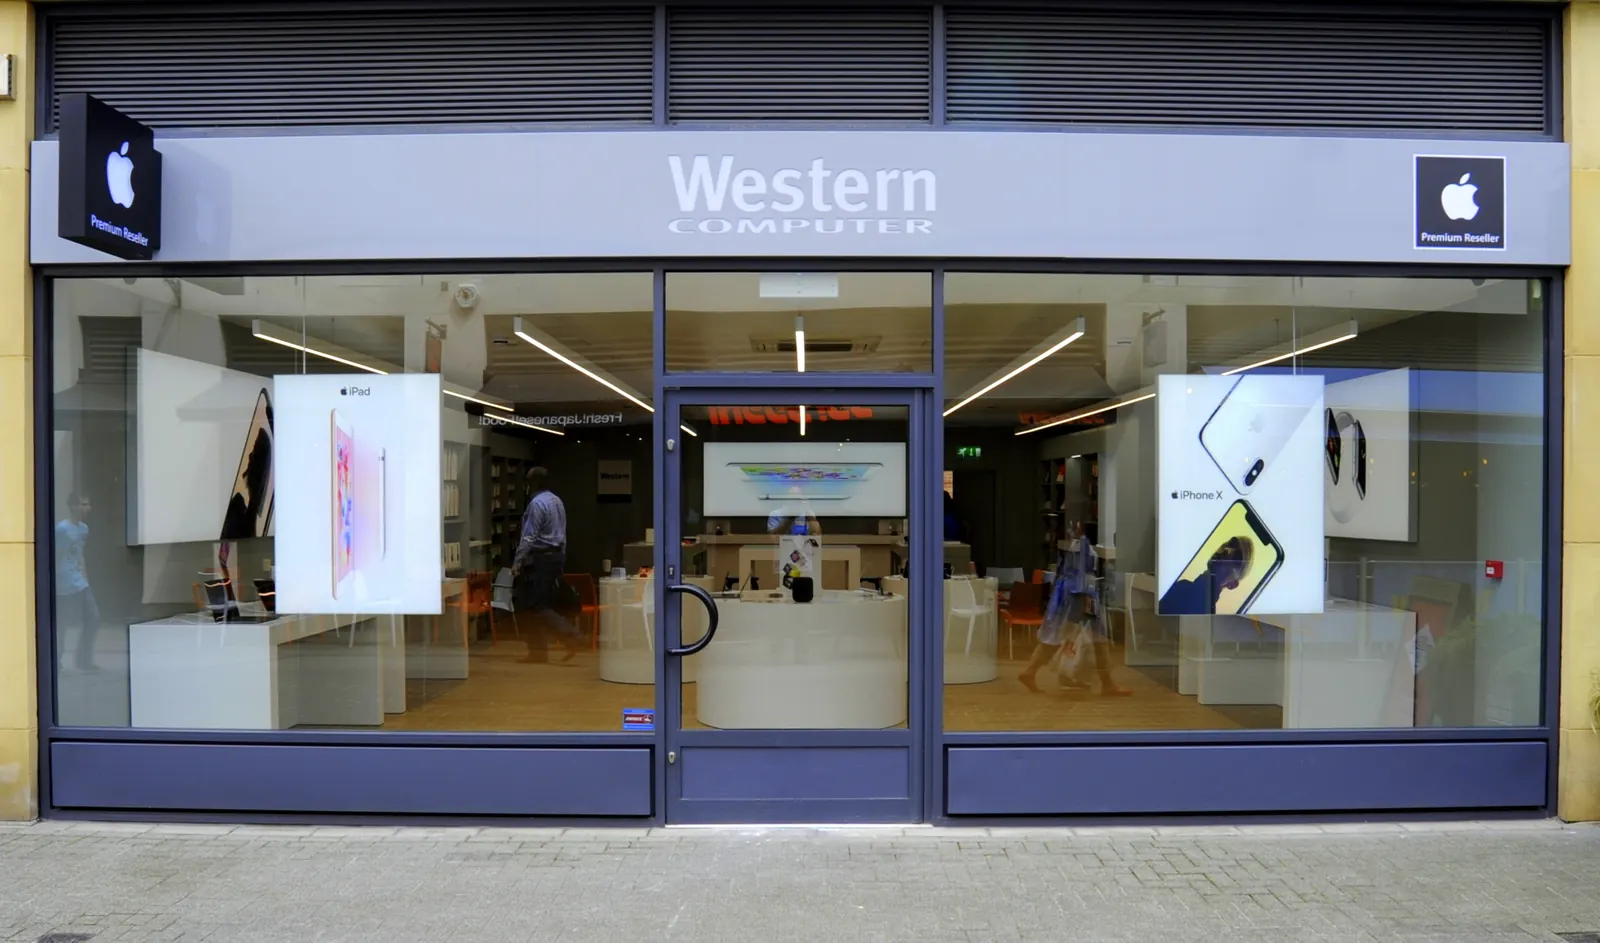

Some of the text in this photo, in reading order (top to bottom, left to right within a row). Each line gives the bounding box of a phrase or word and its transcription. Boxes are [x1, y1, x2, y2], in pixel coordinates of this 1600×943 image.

[668, 155, 936, 212] Western
[91, 214, 149, 246] Premium Reseller
[668, 218, 933, 234] COMPUTER
[1421, 232, 1500, 243] Premium Reseller
[349, 386, 370, 396] iPad
[1180, 490, 1223, 500] iPhone X
